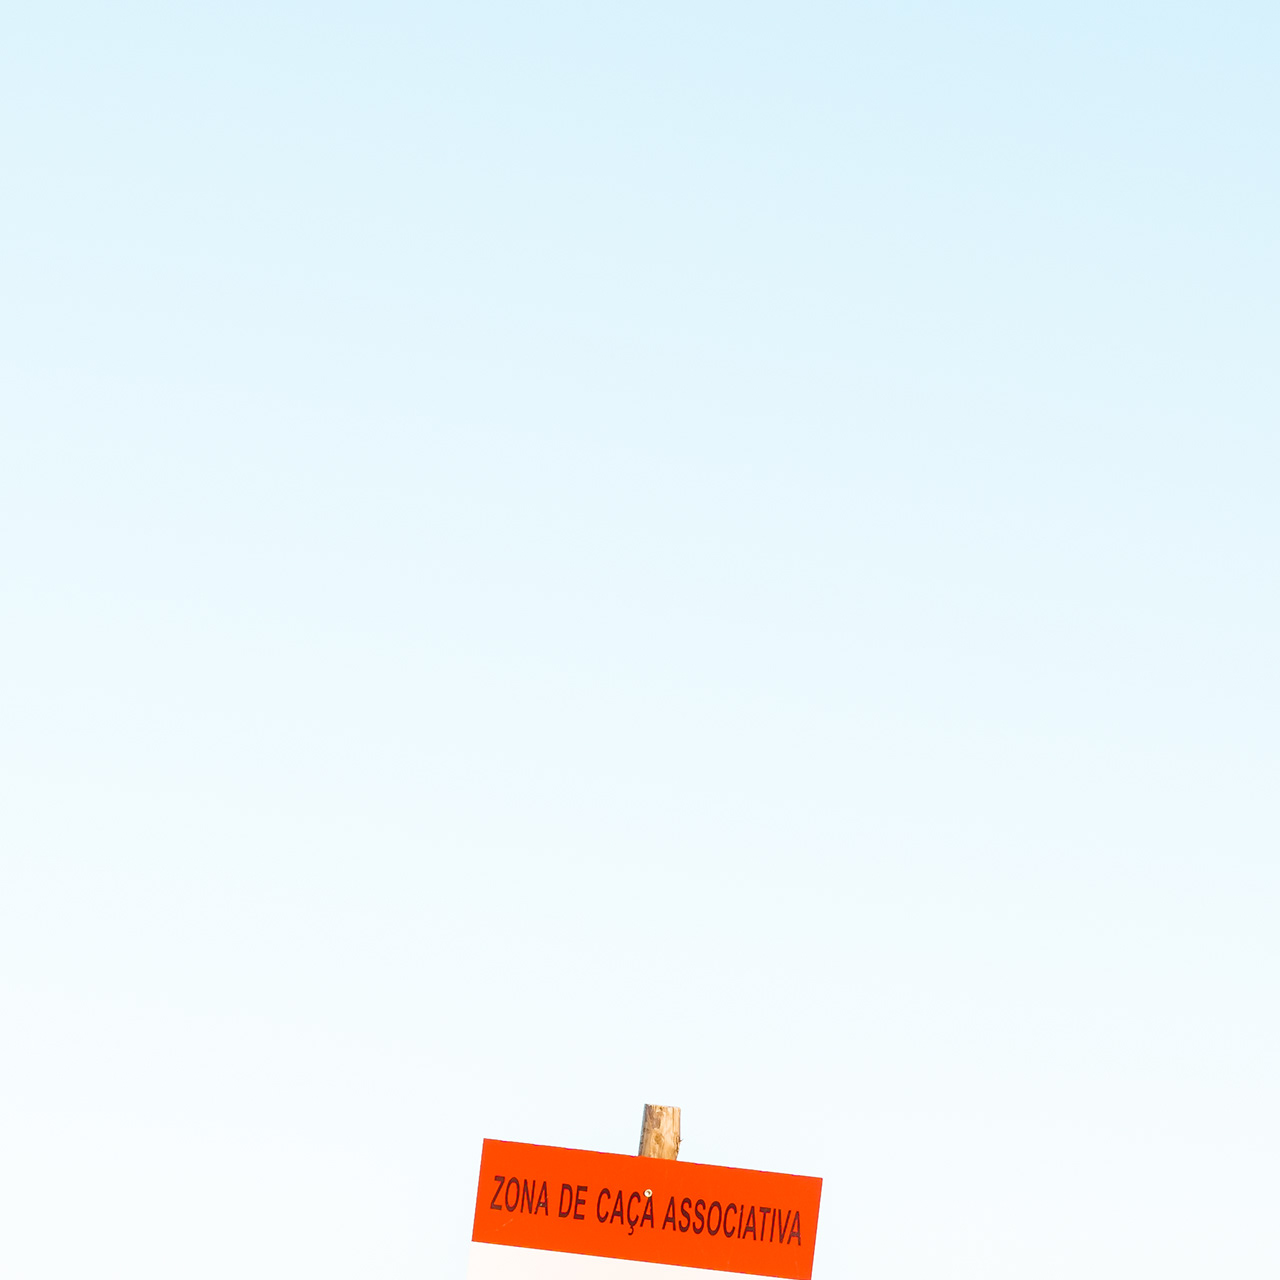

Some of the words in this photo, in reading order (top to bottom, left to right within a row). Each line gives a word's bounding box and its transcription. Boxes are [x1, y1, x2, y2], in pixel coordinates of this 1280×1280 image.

[491, 1176, 548, 1216] ZONA
[559, 1184, 588, 1220] DE
[597, 1188, 654, 1235] CAÇA
[662, 1196, 800, 1245] ASSOCIATIVA
